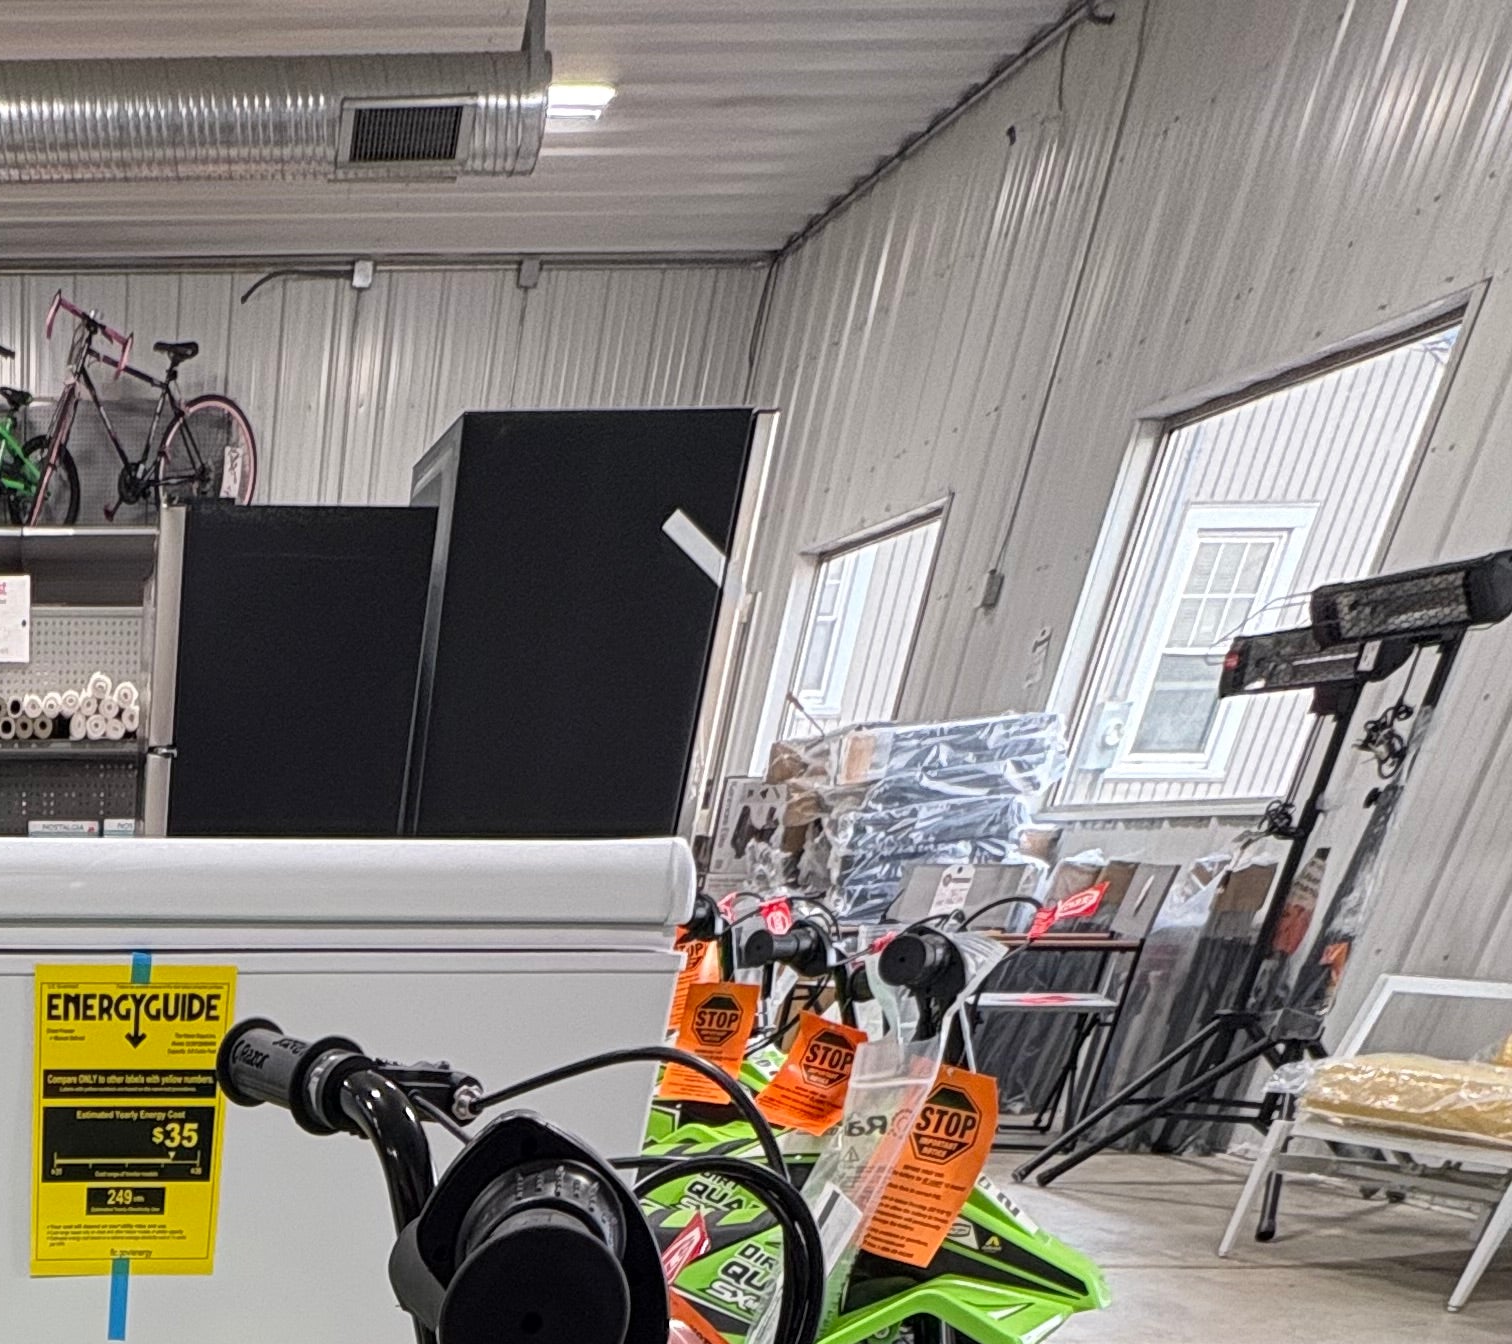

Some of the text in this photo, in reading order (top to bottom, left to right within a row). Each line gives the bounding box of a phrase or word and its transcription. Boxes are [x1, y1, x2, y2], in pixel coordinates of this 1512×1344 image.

[46, 993, 221, 1022] ENERGYGUIDE
[695, 1011, 738, 1028] STOP
[805, 1044, 855, 1072] STOP
[47, 1074, 77, 1085] Compare
[79, 1075, 98, 1084] ONLY
[107, 1075, 124, 1084] other
[125, 1074, 144, 1084] labels
[146, 1075, 160, 1084] with
[161, 1075, 182, 1086] yellow
[76, 1110, 186, 1121] Estimated Yearly Energy Cost
[916, 1106, 977, 1139] STOP
[151, 1122, 199, 1148] $35
[107, 1189, 133, 1205] 249
[687, 1180, 745, 1211] QUA
